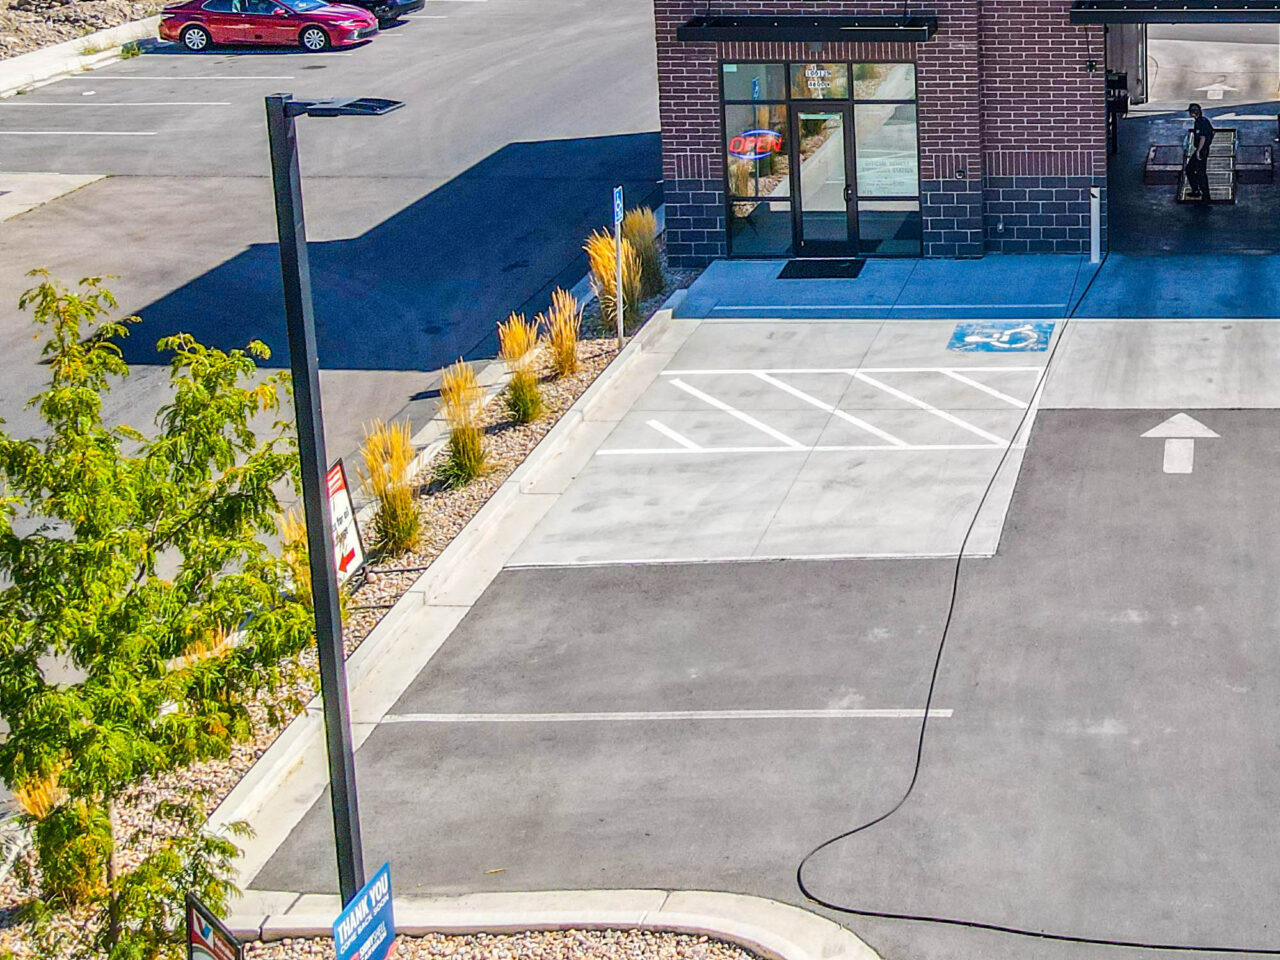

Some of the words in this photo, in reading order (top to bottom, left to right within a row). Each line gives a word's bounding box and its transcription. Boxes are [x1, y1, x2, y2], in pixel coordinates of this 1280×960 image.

[729, 135, 783, 153] OPEN
[337, 895, 370, 944] THANK
[369, 872, 389, 907] YOU
[340, 931, 358, 955] COME
[373, 892, 390, 917] SOON
